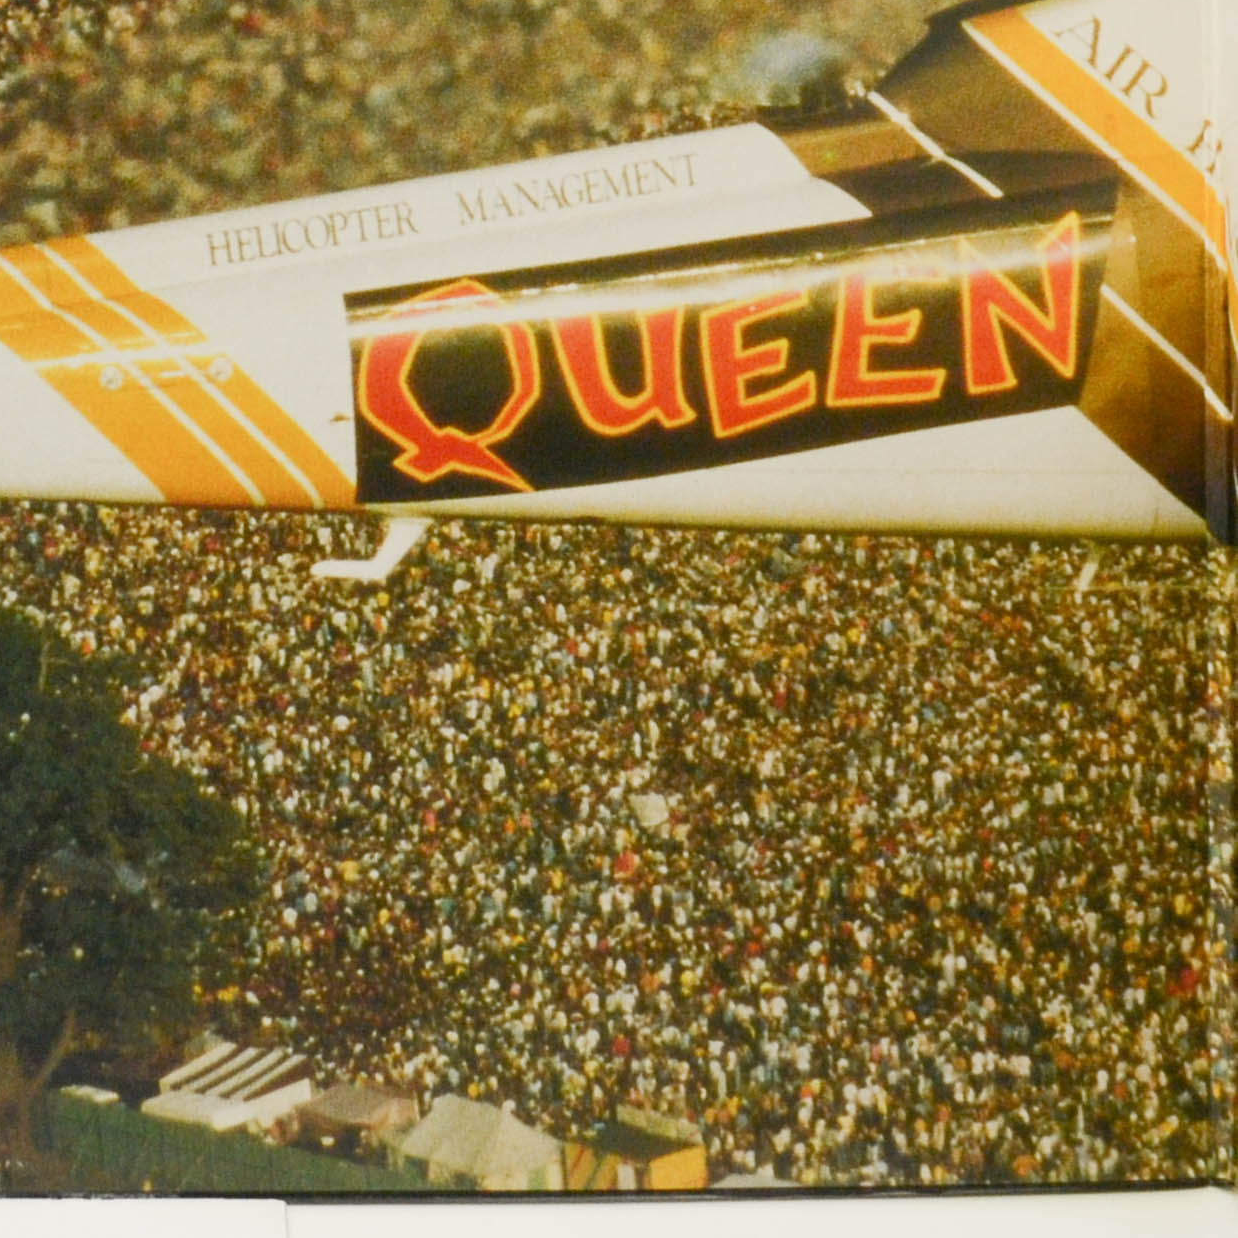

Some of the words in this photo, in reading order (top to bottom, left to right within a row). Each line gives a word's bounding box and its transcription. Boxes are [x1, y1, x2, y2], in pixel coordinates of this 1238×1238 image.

[1049, 14, 1169, 119] AIR
[206, 202, 418, 266] HELICOPTER
[454, 153, 697, 226] MANAGEMENT
[359, 211, 1080, 493] QUEEN
